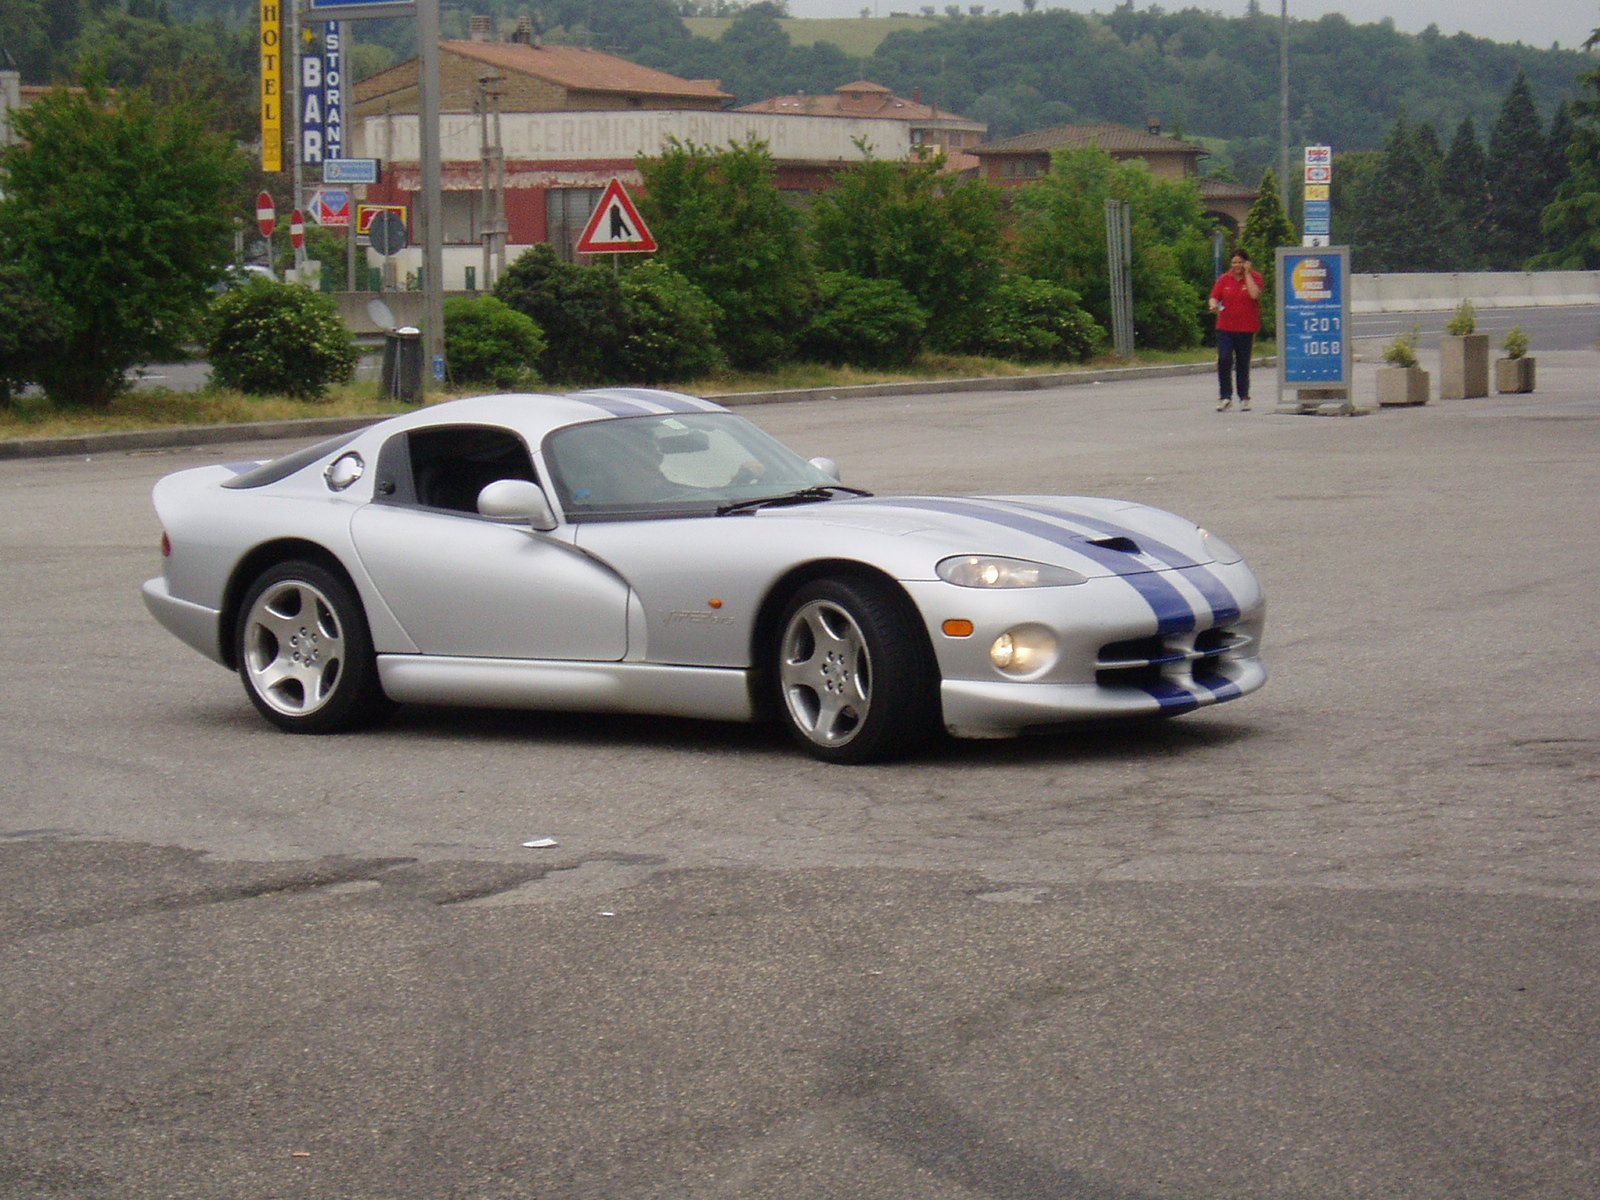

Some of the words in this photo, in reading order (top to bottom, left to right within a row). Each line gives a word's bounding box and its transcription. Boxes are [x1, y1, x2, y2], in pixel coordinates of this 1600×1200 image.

[263, 5, 277, 120] HOTEL
[303, 56, 323, 163] BAR
[326, 20, 340, 159] ISTORANT
